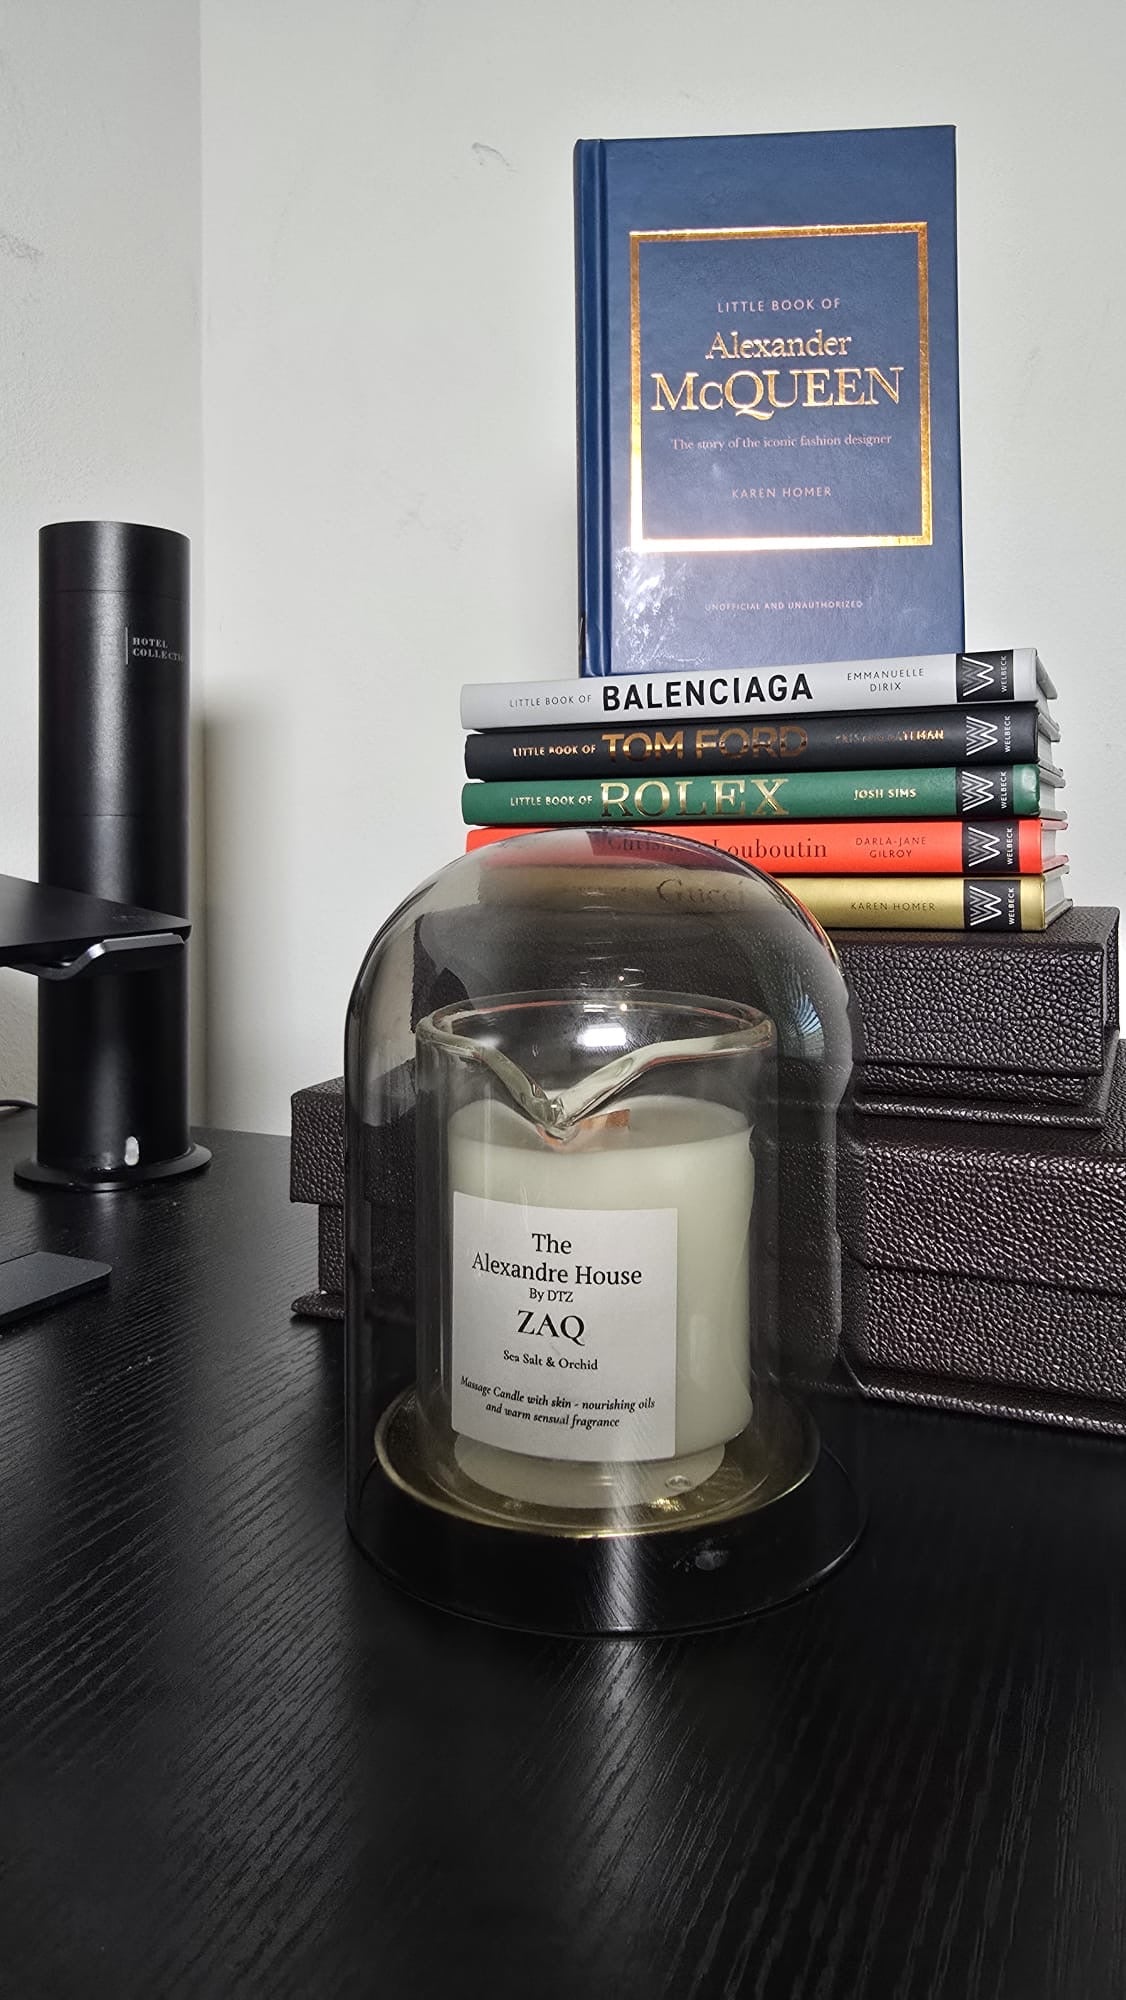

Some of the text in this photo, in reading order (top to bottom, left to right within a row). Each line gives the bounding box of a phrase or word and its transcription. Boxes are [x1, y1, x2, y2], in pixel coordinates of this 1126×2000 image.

[717, 298, 841, 313] LITTLE BOOK OF
[705, 329, 852, 359] Alexander
[650, 367, 904, 420] McQUEEN
[671, 434, 892, 451] The story of the iconic fashion designer
[732, 486, 832, 499] KAREN HOMER
[705, 600, 864, 612] UNOFFICIAL AND UNAUTHORIZED
[132, 637, 168, 648] HOTEL
[847, 668, 925, 681] EMMANUELLE
[869, 681, 902, 692] DIRIX
[1000, 655, 1008, 693] WELBECK
[509, 673, 813, 711] LITTLE BOOK OF BALENCIAGA
[512, 746, 545, 758] LITTLE
[581, 744, 597, 755] OF
[601, 730, 684, 762] TOM
[695, 725, 808, 761] FORD
[1003, 715, 1011, 753] WELBECK
[510, 778, 789, 818] LITTLE BOOK OF ROLEX
[854, 787, 917, 800] JOSH SIMS
[1000, 771, 1008, 809] WELBECK
[855, 836, 927, 847] DARLA-JANE
[869, 849, 913, 859] GILROY
[1006, 827, 1014, 865] WELBECK
[850, 901, 936, 912] KAREN HOMER
[1008, 887, 1016, 925] WELBECK
[531, 1232, 572, 1255] The
[471, 1252, 643, 1285] Alexandre House
[529, 1288, 574, 1303] By DTZ
[517, 1309, 586, 1346] ZAQ
[503, 1351, 599, 1371] Sea Salt & Orchid
[460, 1375, 491, 1396] Massage
[493, 1386, 524, 1402] Candle
[527, 1394, 549, 1407] with
[551, 1396, 571, 1409] skin
[582, 1398, 636, 1413] nourishing
[638, 1397, 656, 1410] oils
[486, 1402, 620, 1430] and warm sensual fragrance
